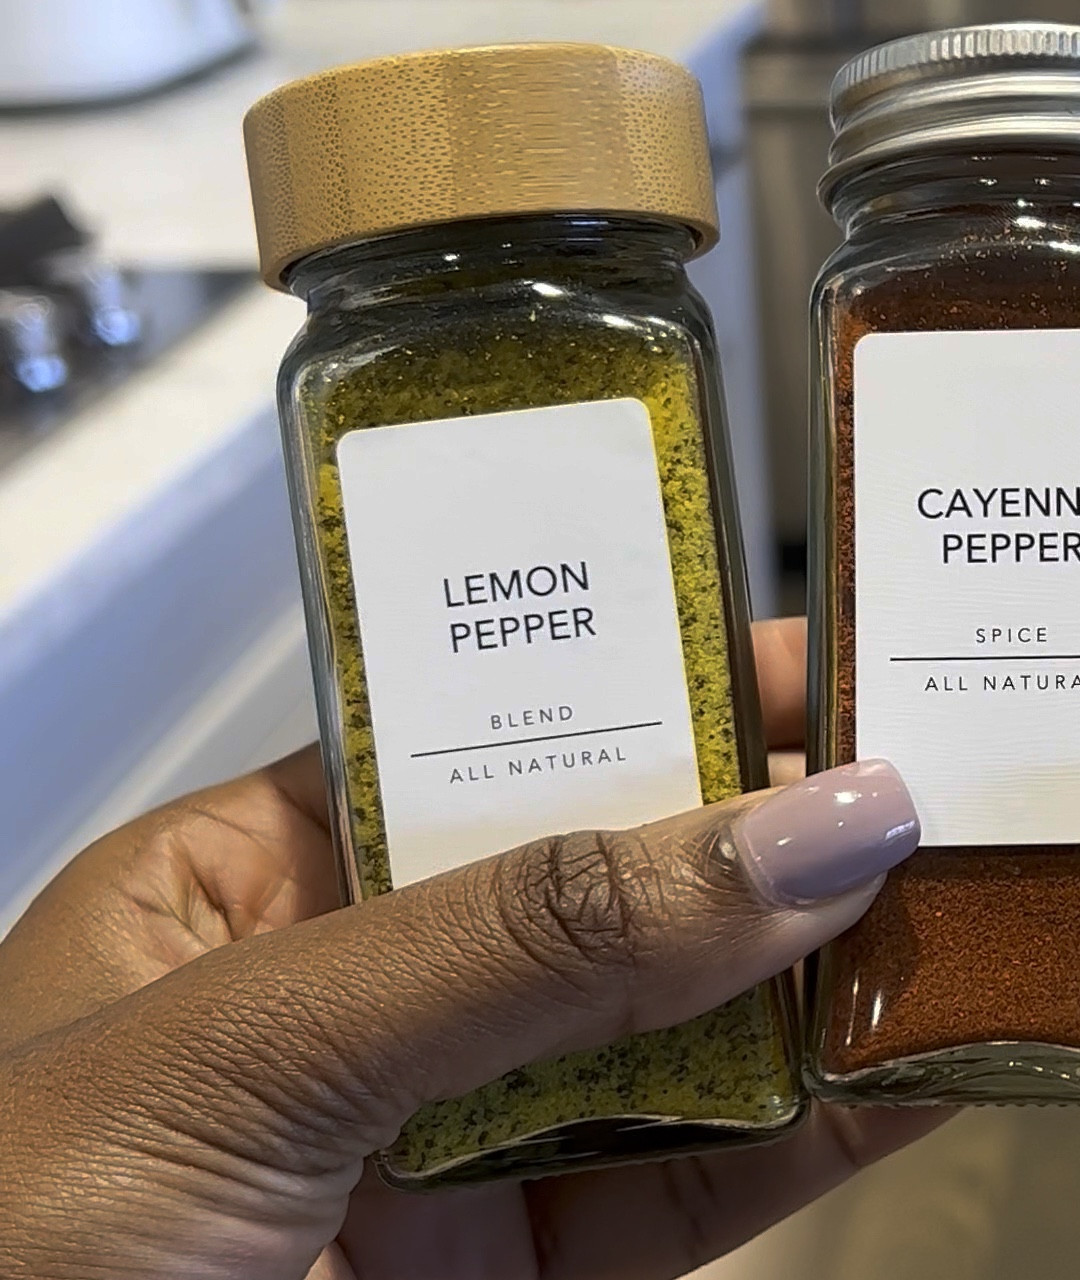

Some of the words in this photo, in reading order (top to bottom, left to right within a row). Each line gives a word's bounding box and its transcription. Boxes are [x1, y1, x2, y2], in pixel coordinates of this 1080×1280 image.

[443, 560, 590, 608] LEMON
[449, 606, 597, 653] PEPPER
[975, 627, 1047, 644] SPICE
[924, 676, 968, 692] ALL
[490, 705, 573, 730] BLEND
[449, 764, 495, 784] ALL
[508, 747, 626, 776] NATURAL
